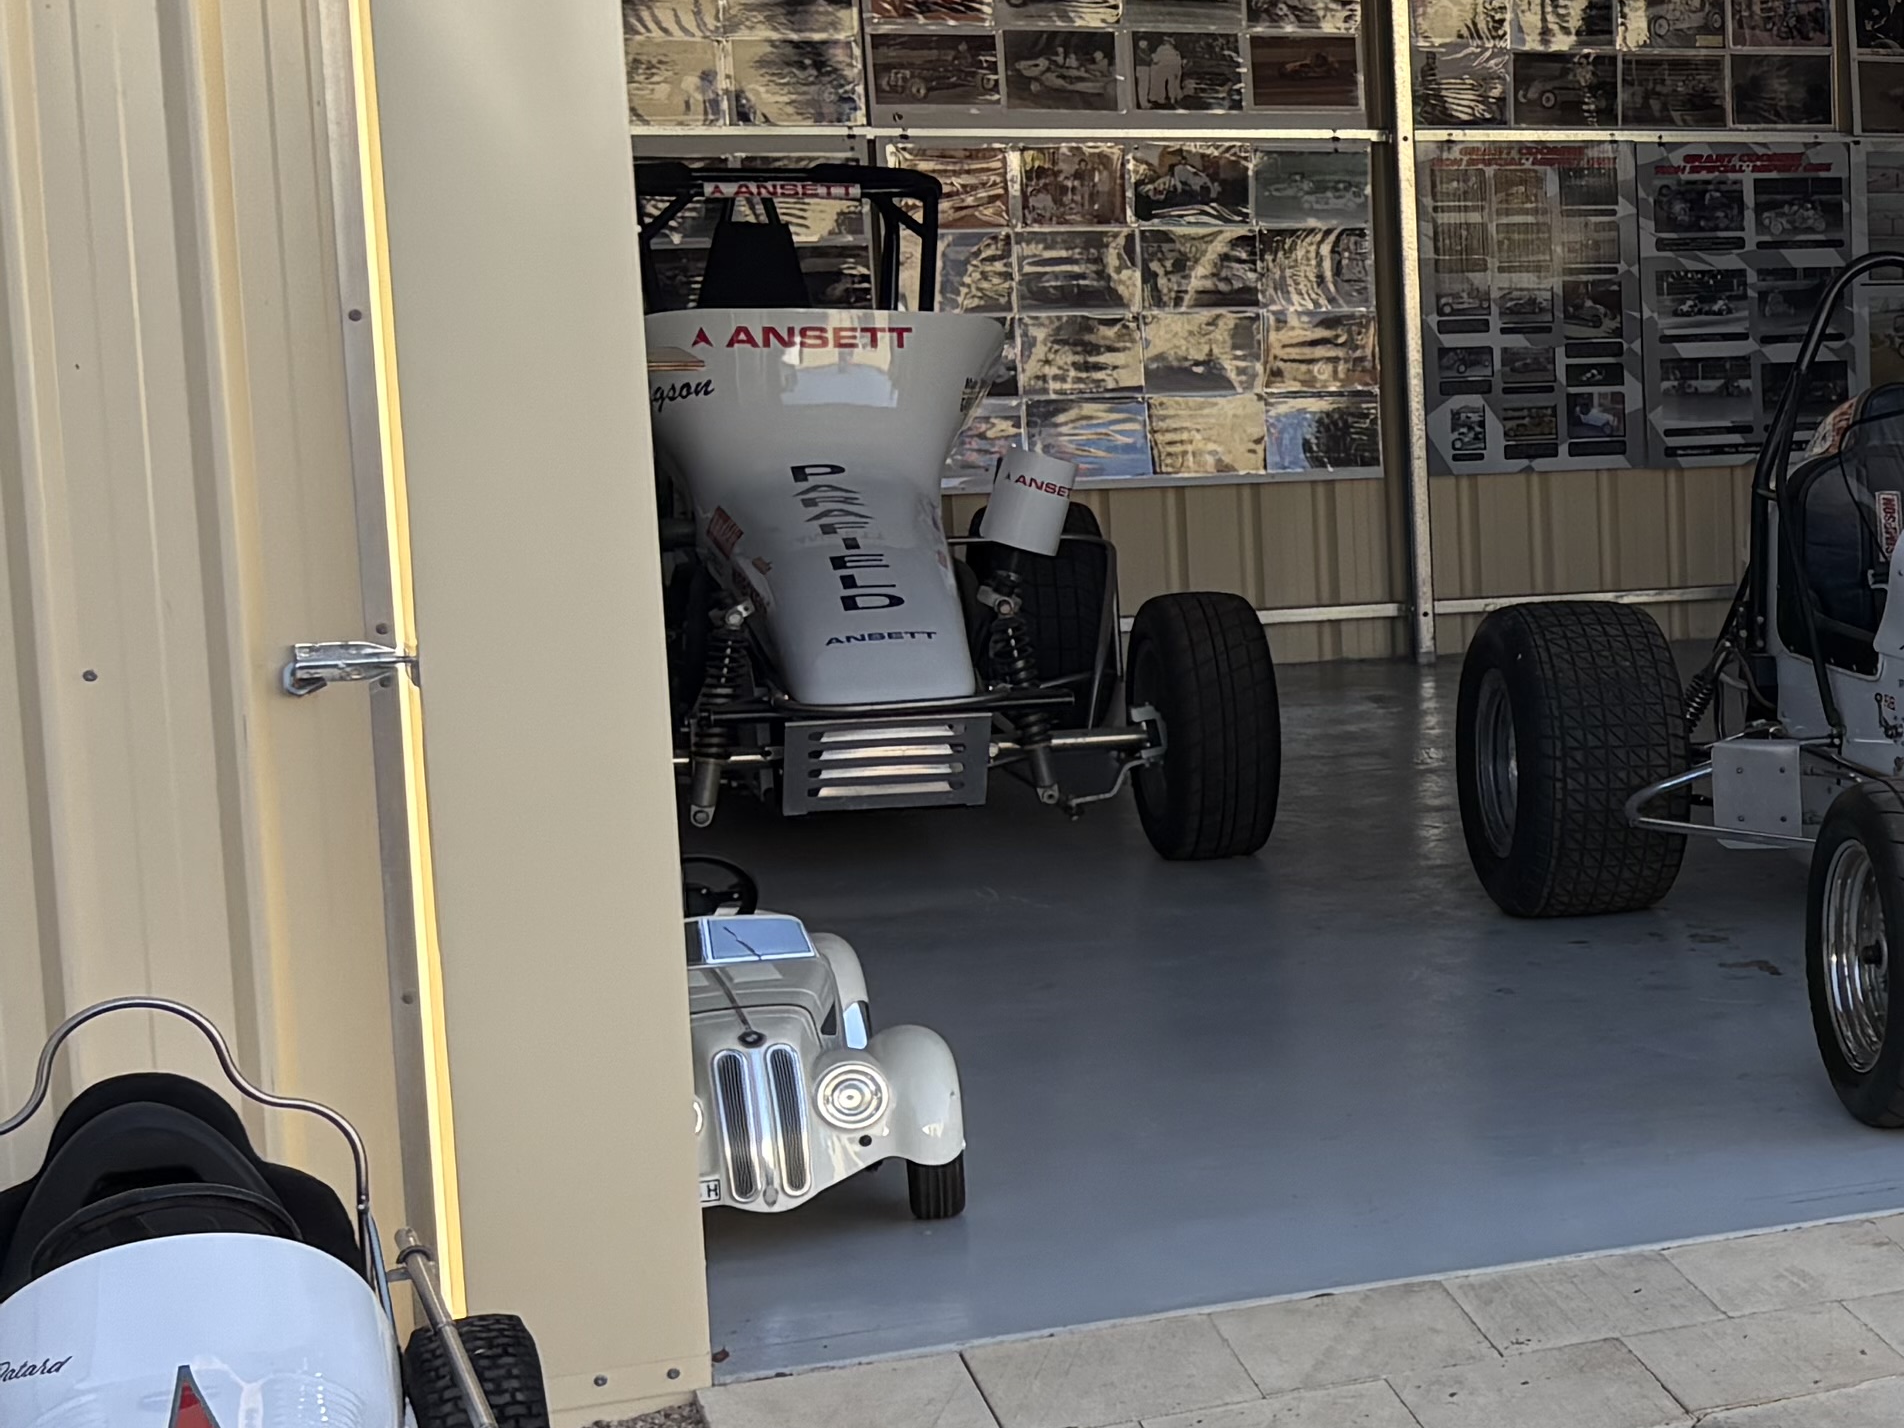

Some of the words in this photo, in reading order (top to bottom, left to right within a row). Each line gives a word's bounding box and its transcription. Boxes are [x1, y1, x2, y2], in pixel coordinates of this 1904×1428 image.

[733, 183, 856, 197] ANSETT
[726, 326, 913, 349] ANSETT
[824, 630, 938, 647] ANSETT
[707, 1183, 719, 1199] H
